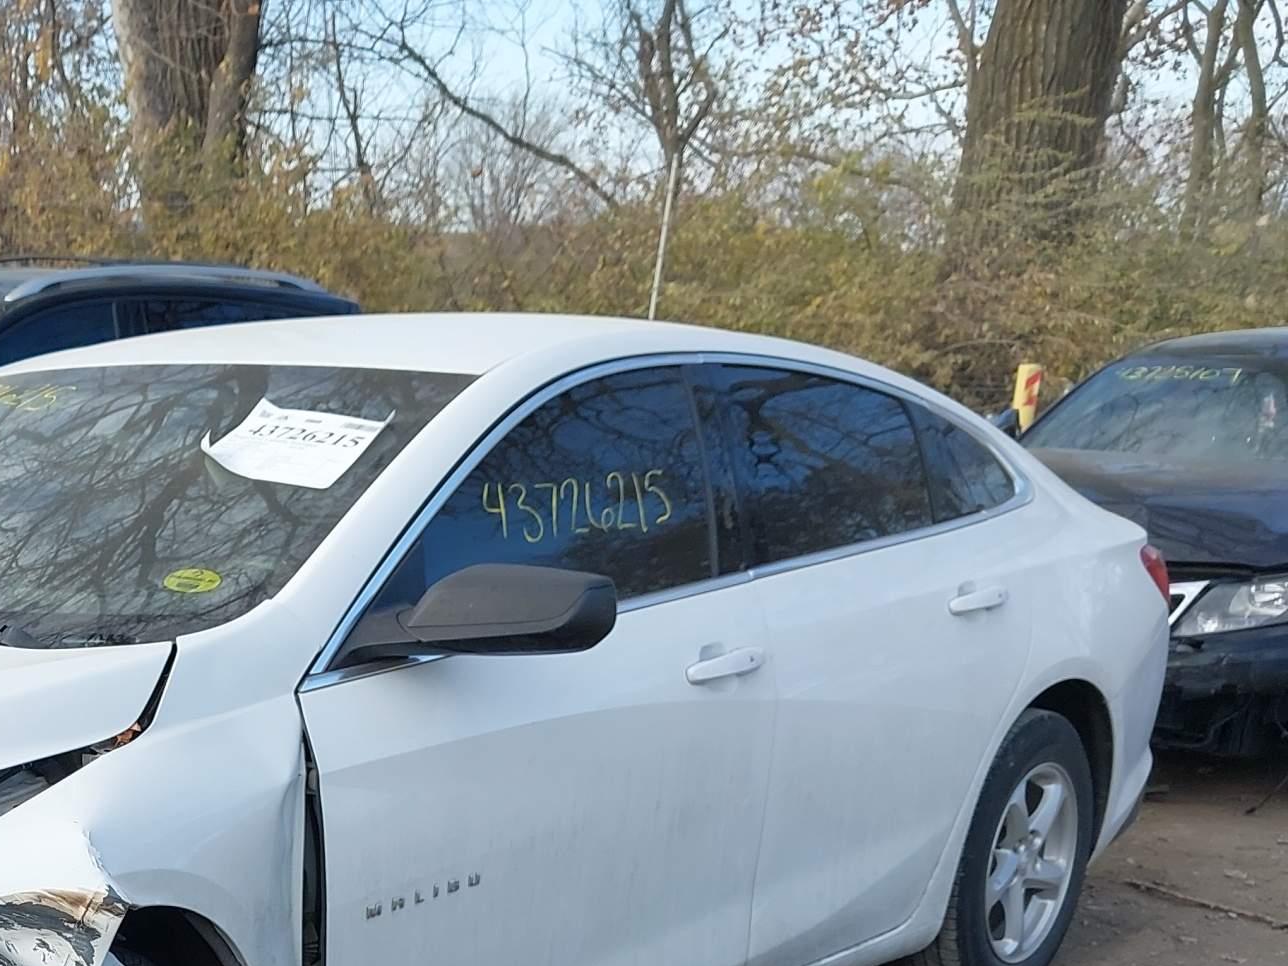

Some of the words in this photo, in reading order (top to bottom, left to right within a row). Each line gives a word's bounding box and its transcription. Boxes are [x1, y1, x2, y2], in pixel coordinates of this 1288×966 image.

[248, 424, 366, 448] 43726215
[482, 468, 672, 543] 43726215
[365, 872, 481, 920] MALIBU
